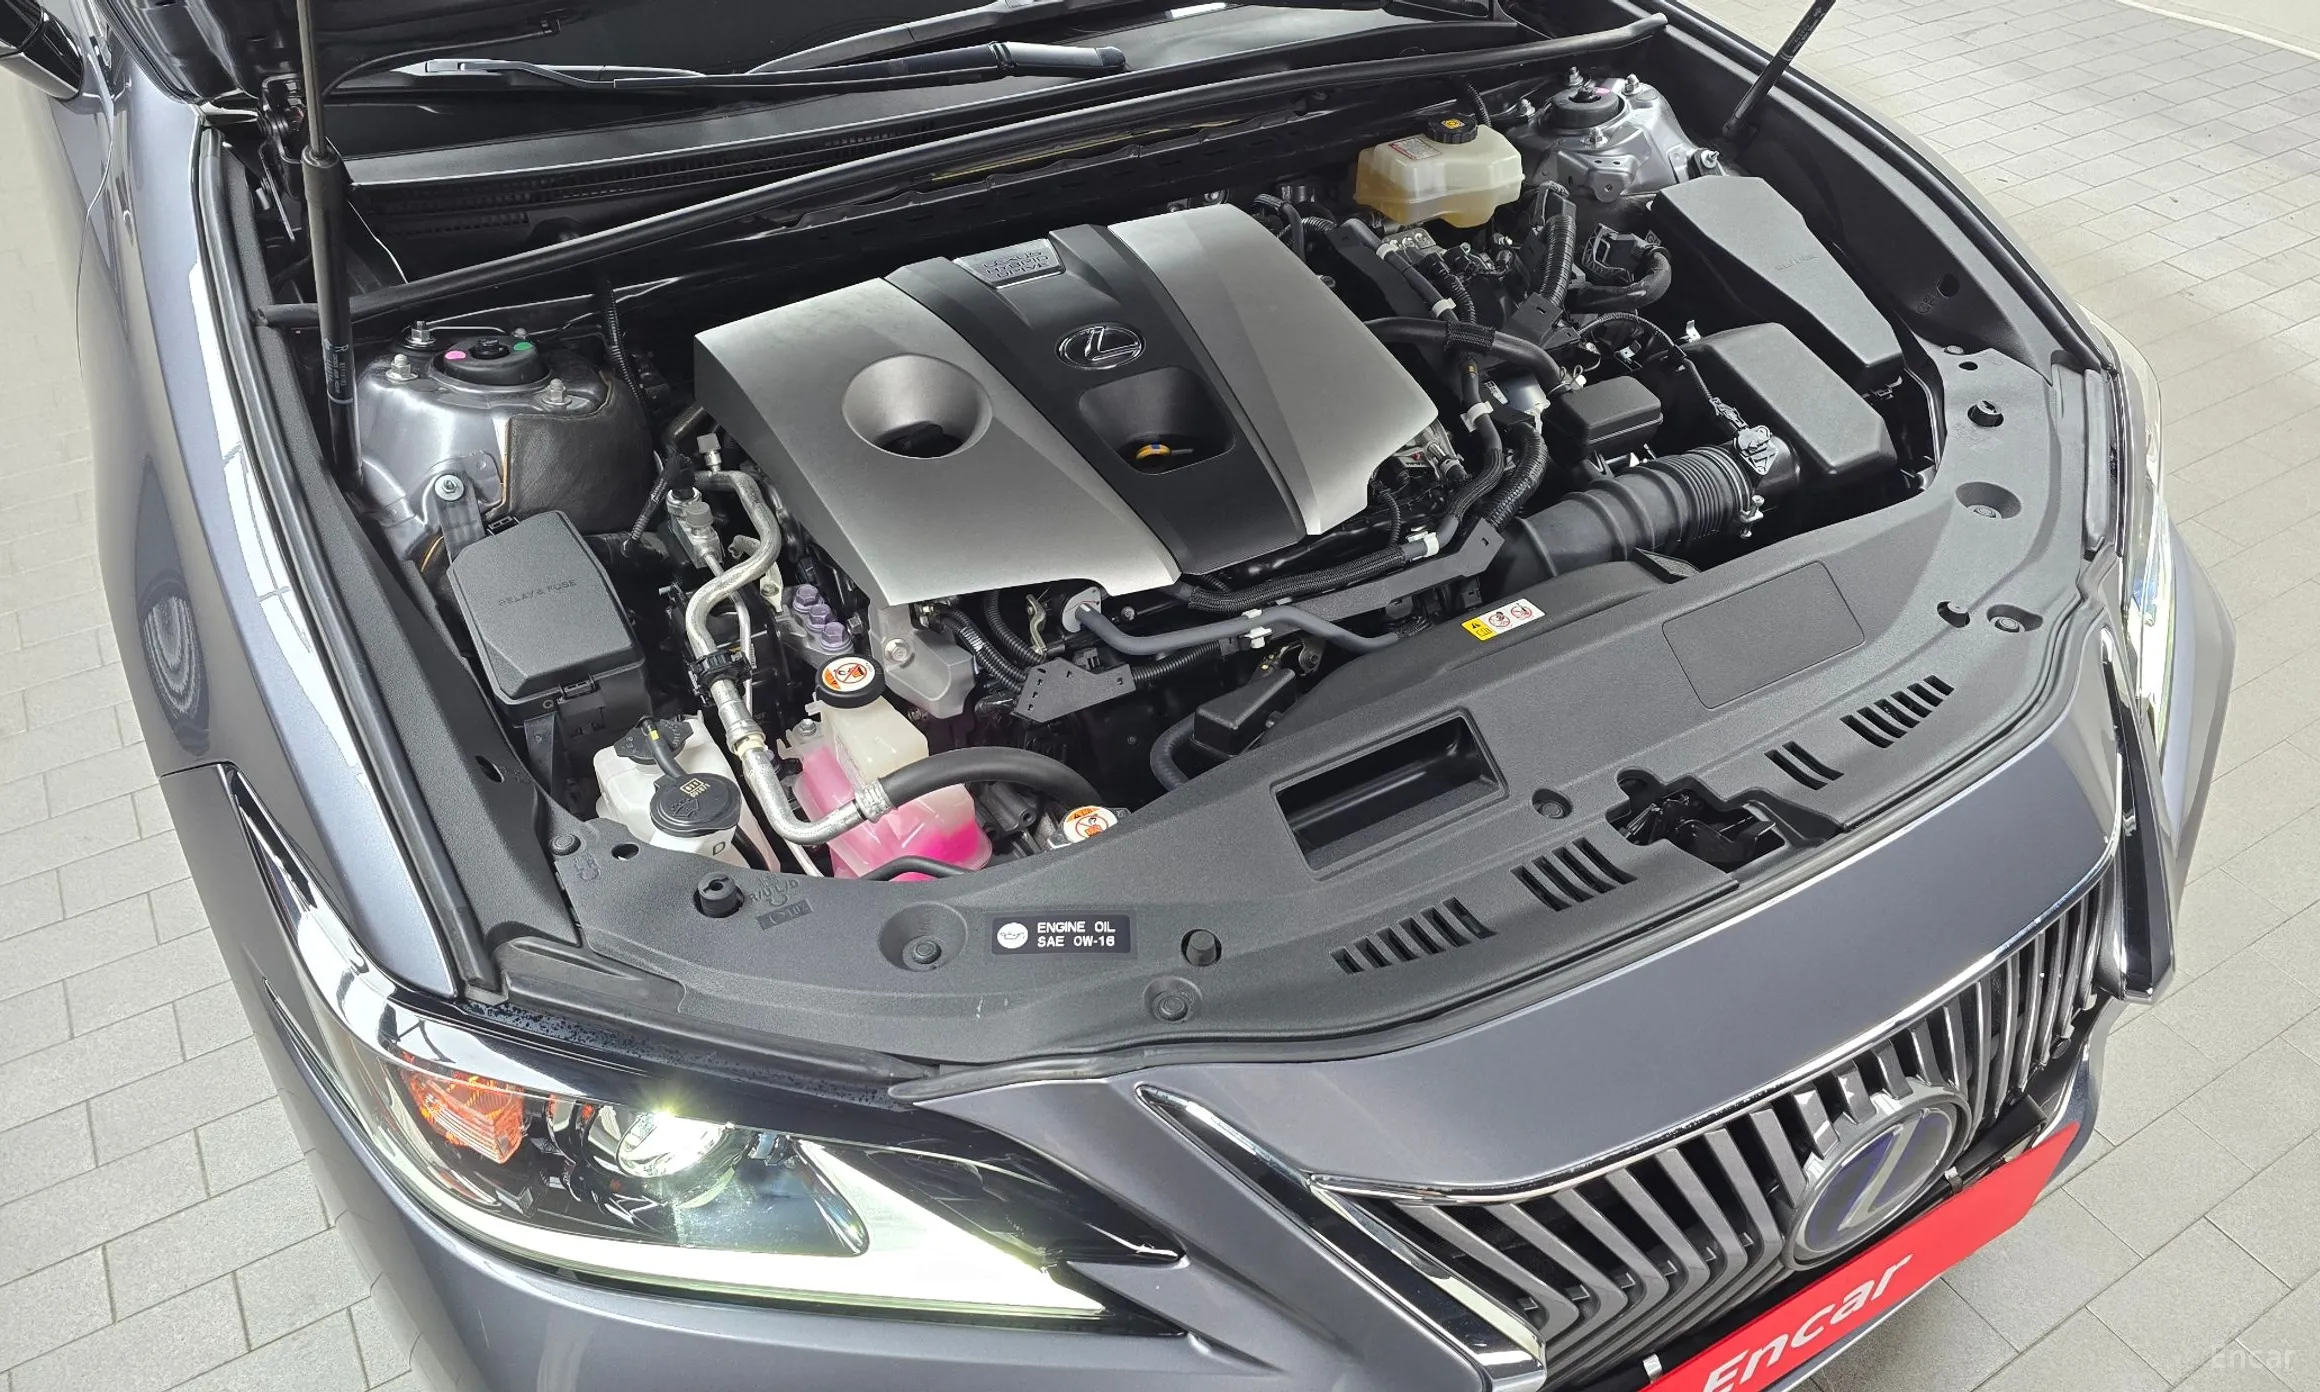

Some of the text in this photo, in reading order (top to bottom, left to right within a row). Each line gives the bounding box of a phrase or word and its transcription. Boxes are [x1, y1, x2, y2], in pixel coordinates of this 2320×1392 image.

[1037, 920, 1116, 934] ENGINE OIL
[1037, 935, 1115, 948] SAE 0W-16
[1701, 1253, 1914, 1392] Encar
